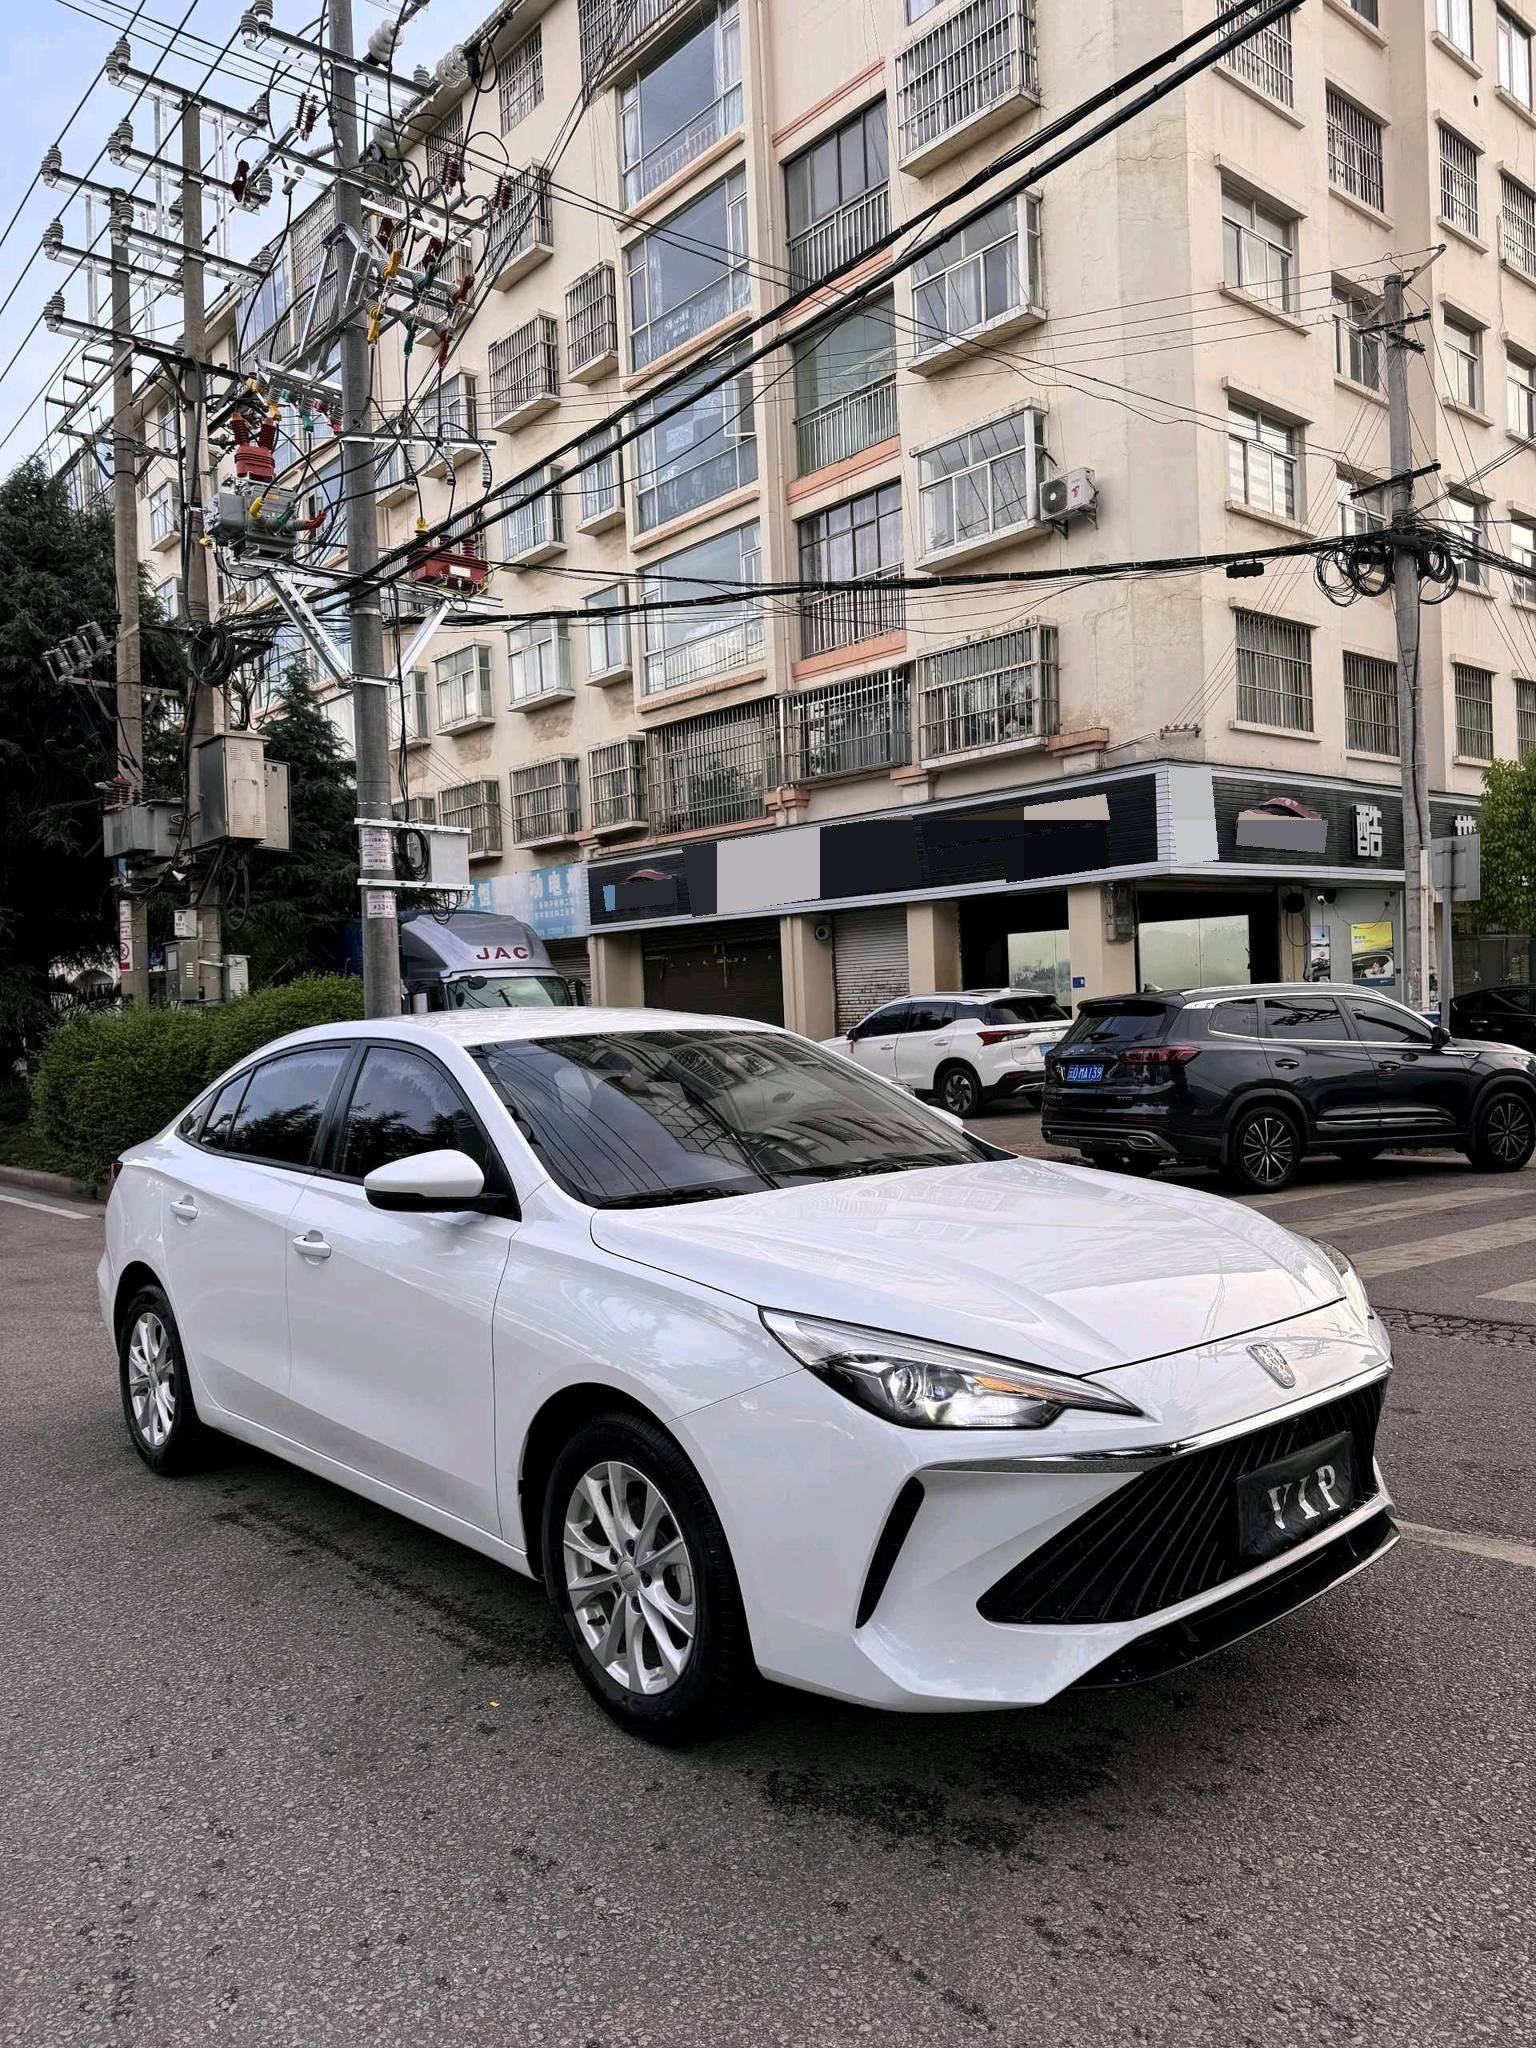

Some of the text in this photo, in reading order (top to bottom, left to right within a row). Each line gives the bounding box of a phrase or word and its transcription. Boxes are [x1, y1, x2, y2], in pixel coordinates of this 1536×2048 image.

[1354, 803, 1383, 857] 酷
[476, 946, 529, 960] JAC
[1267, 1465, 1340, 1529] VIP
